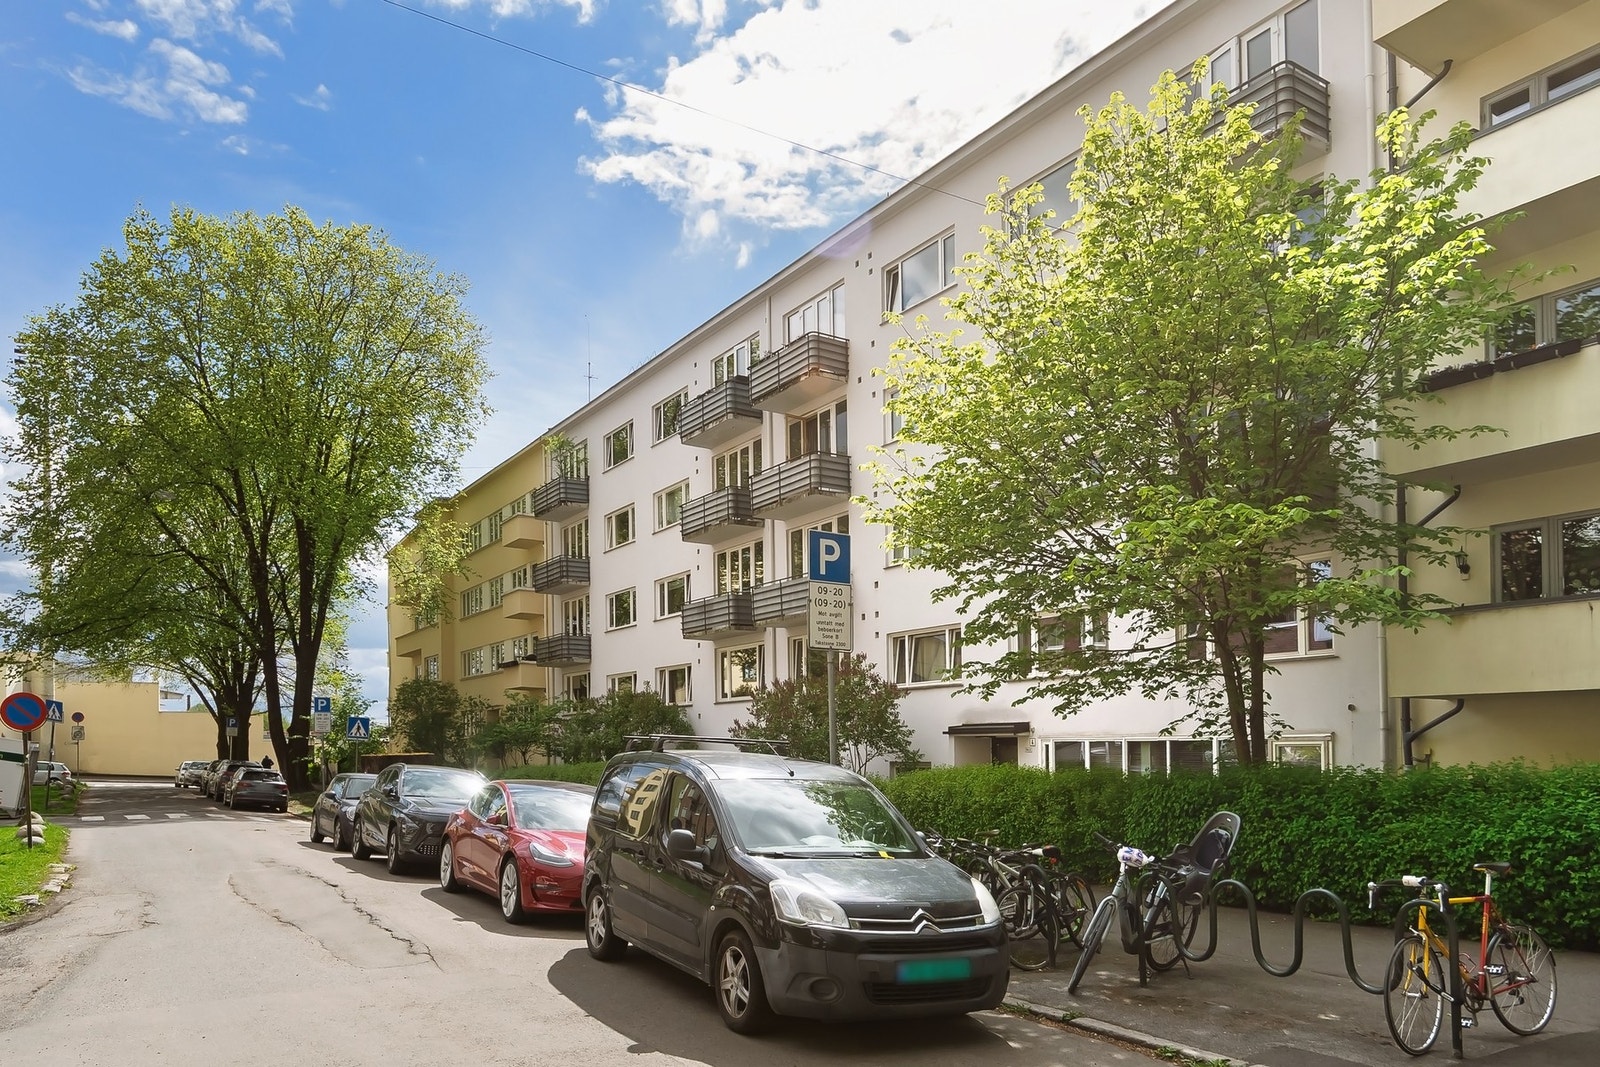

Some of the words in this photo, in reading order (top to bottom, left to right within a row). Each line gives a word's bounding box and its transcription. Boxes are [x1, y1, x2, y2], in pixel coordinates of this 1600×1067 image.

[819, 538, 841, 575] P
[318, 699, 327, 711] P
[229, 718, 236, 727] P
